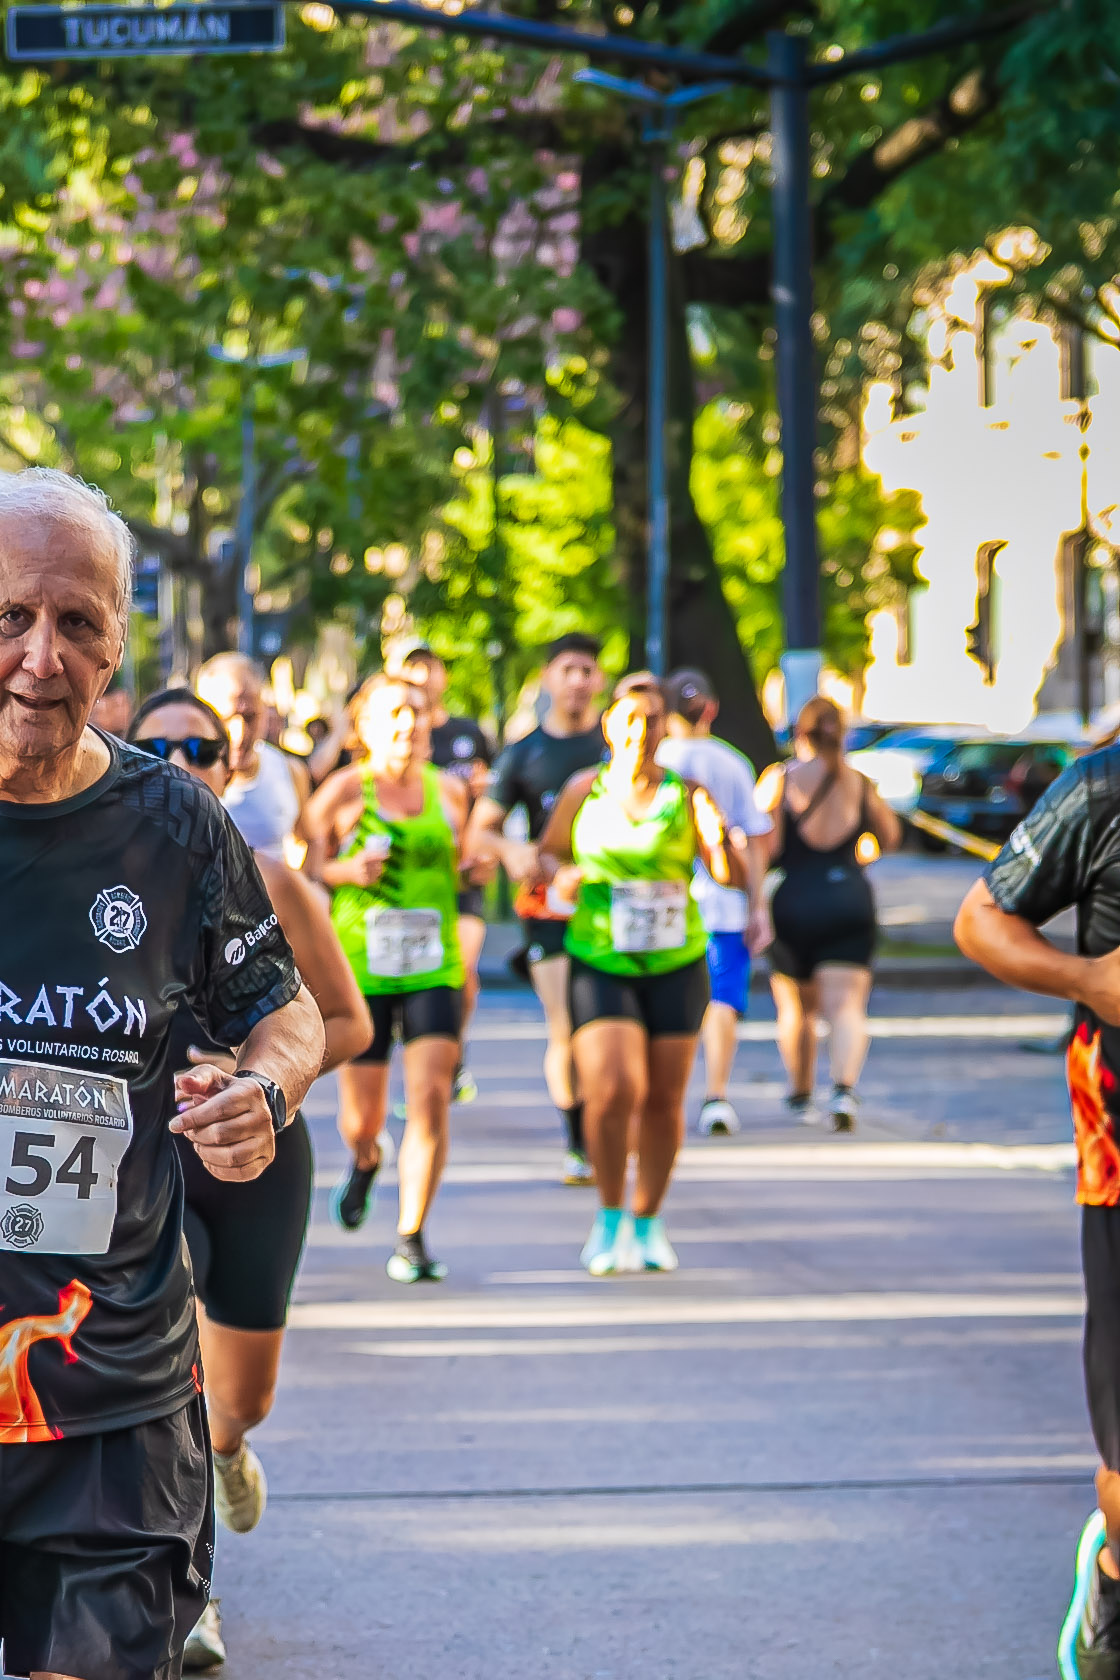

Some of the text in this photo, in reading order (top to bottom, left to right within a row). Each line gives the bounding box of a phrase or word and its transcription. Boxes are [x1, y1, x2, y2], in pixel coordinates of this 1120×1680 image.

[109, 904, 131, 929] 27
[244, 913, 278, 947] Banco
[7, 1038, 99, 1060] VOLUNTARIOS
[43, 1108, 94, 1124] VOLUNTARIOS
[94, 1115, 126, 1128] ROSARIO
[14, 1217, 32, 1232] 27
